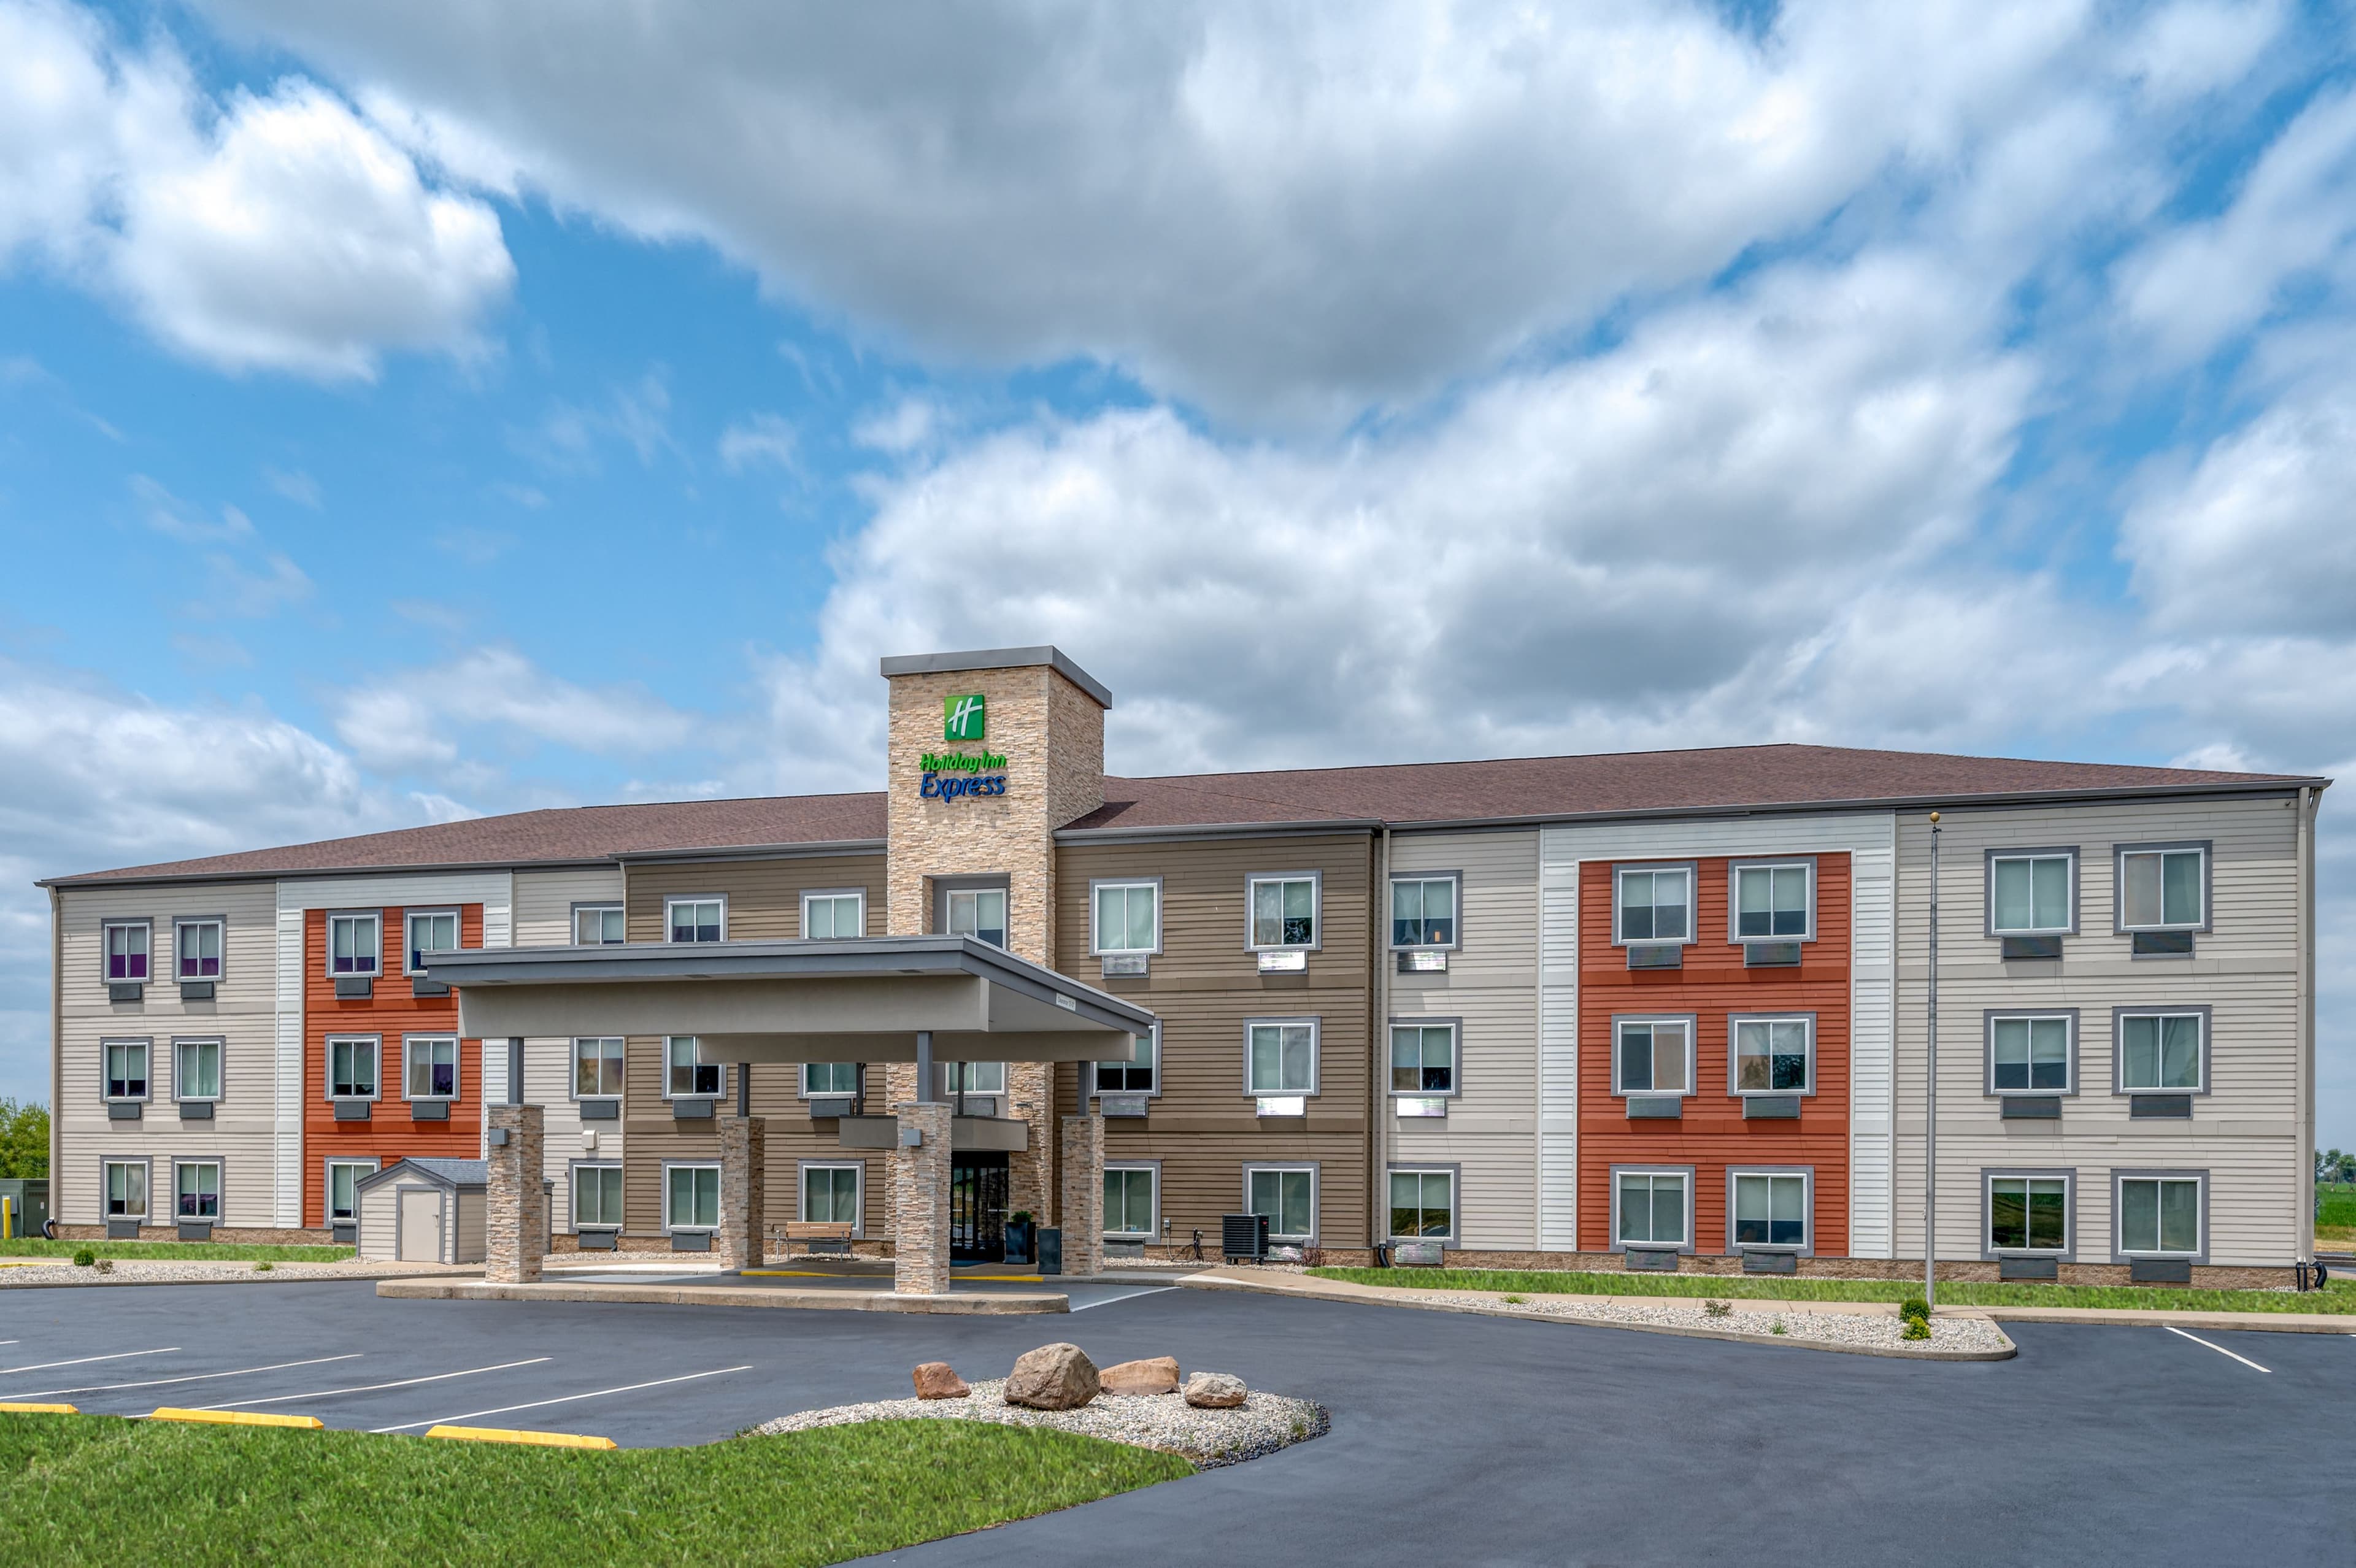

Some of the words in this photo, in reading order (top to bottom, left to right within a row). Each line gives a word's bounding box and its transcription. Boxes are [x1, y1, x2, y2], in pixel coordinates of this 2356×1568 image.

[948, 698, 983, 736] H
[920, 752, 980, 774] Holiday
[982, 750, 1007, 769] Inn
[920, 773, 1006, 804] Express
